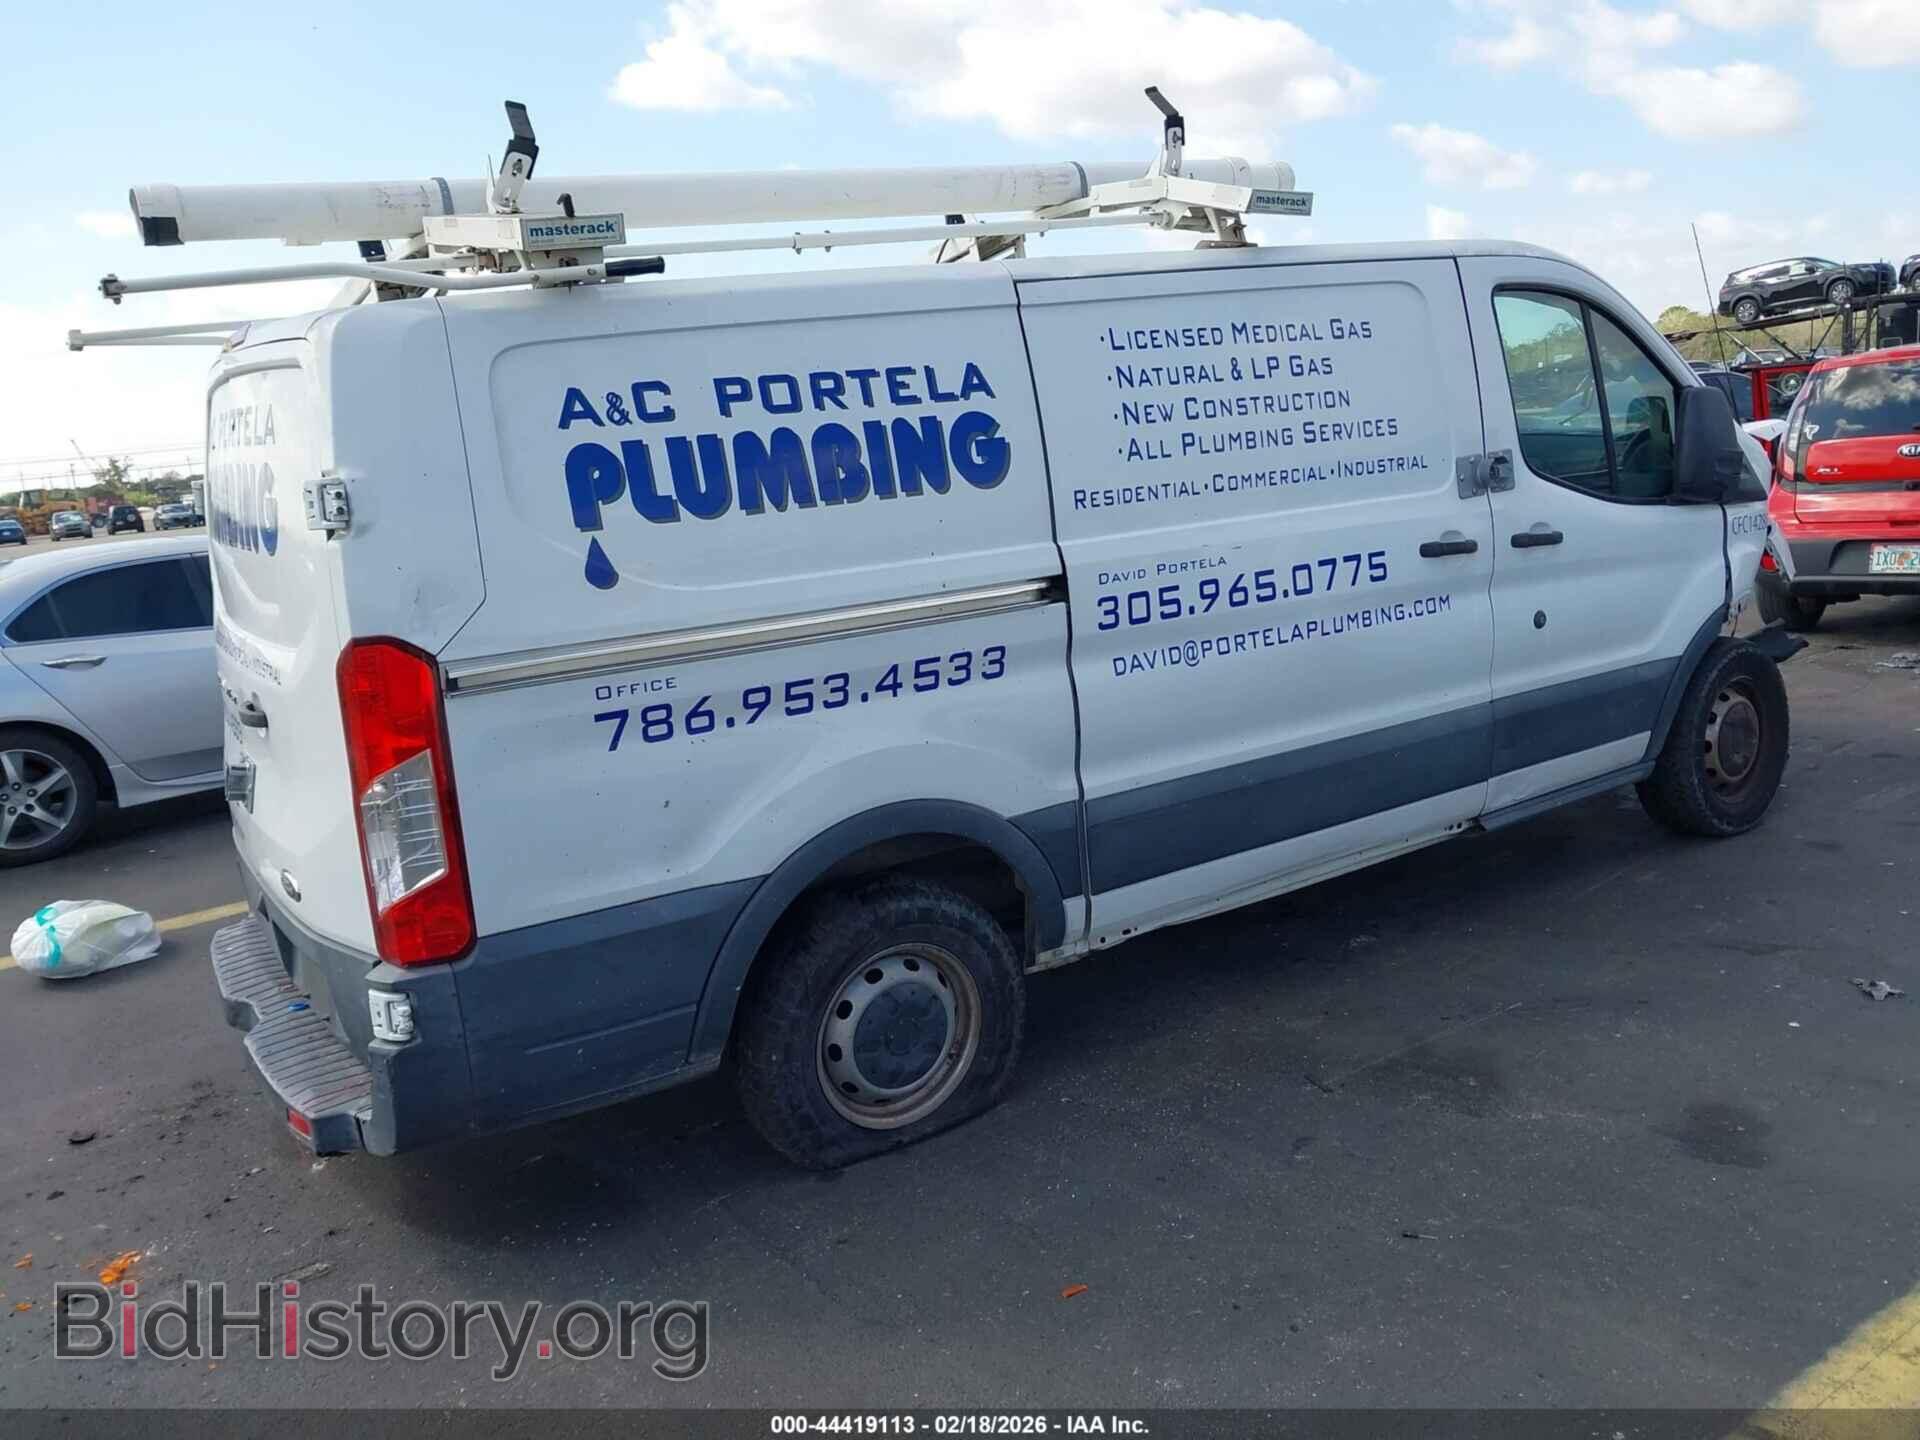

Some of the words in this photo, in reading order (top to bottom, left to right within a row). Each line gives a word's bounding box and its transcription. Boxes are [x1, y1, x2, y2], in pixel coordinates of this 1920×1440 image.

[529, 220, 616, 237] masterack
[1231, 320, 1324, 345] MEDICAL
[1329, 318, 1373, 341] GAS
[1230, 357, 1243, 381] &
[1251, 355, 1280, 381] LP
[1289, 354, 1334, 378] GAS
[558, 380, 676, 429] A&C
[713, 362, 996, 418] PORTELA
[1184, 389, 1351, 422] CONSTRUCTION
[1181, 426, 1294, 457] PLUMBING
[1302, 418, 1399, 444] SERVICES
[564, 410, 1011, 533] PLUMBING
[1098, 567, 1147, 586] DAVID
[1156, 555, 1228, 576] PORTELA
[1097, 550, 1389, 632] 305.965.0775
[1112, 594, 1452, 677] DAVID@PORTELAPLUMBING.COM
[593, 645, 1007, 753] 786.953.4533
[595, 676, 678, 701] OFFICE
